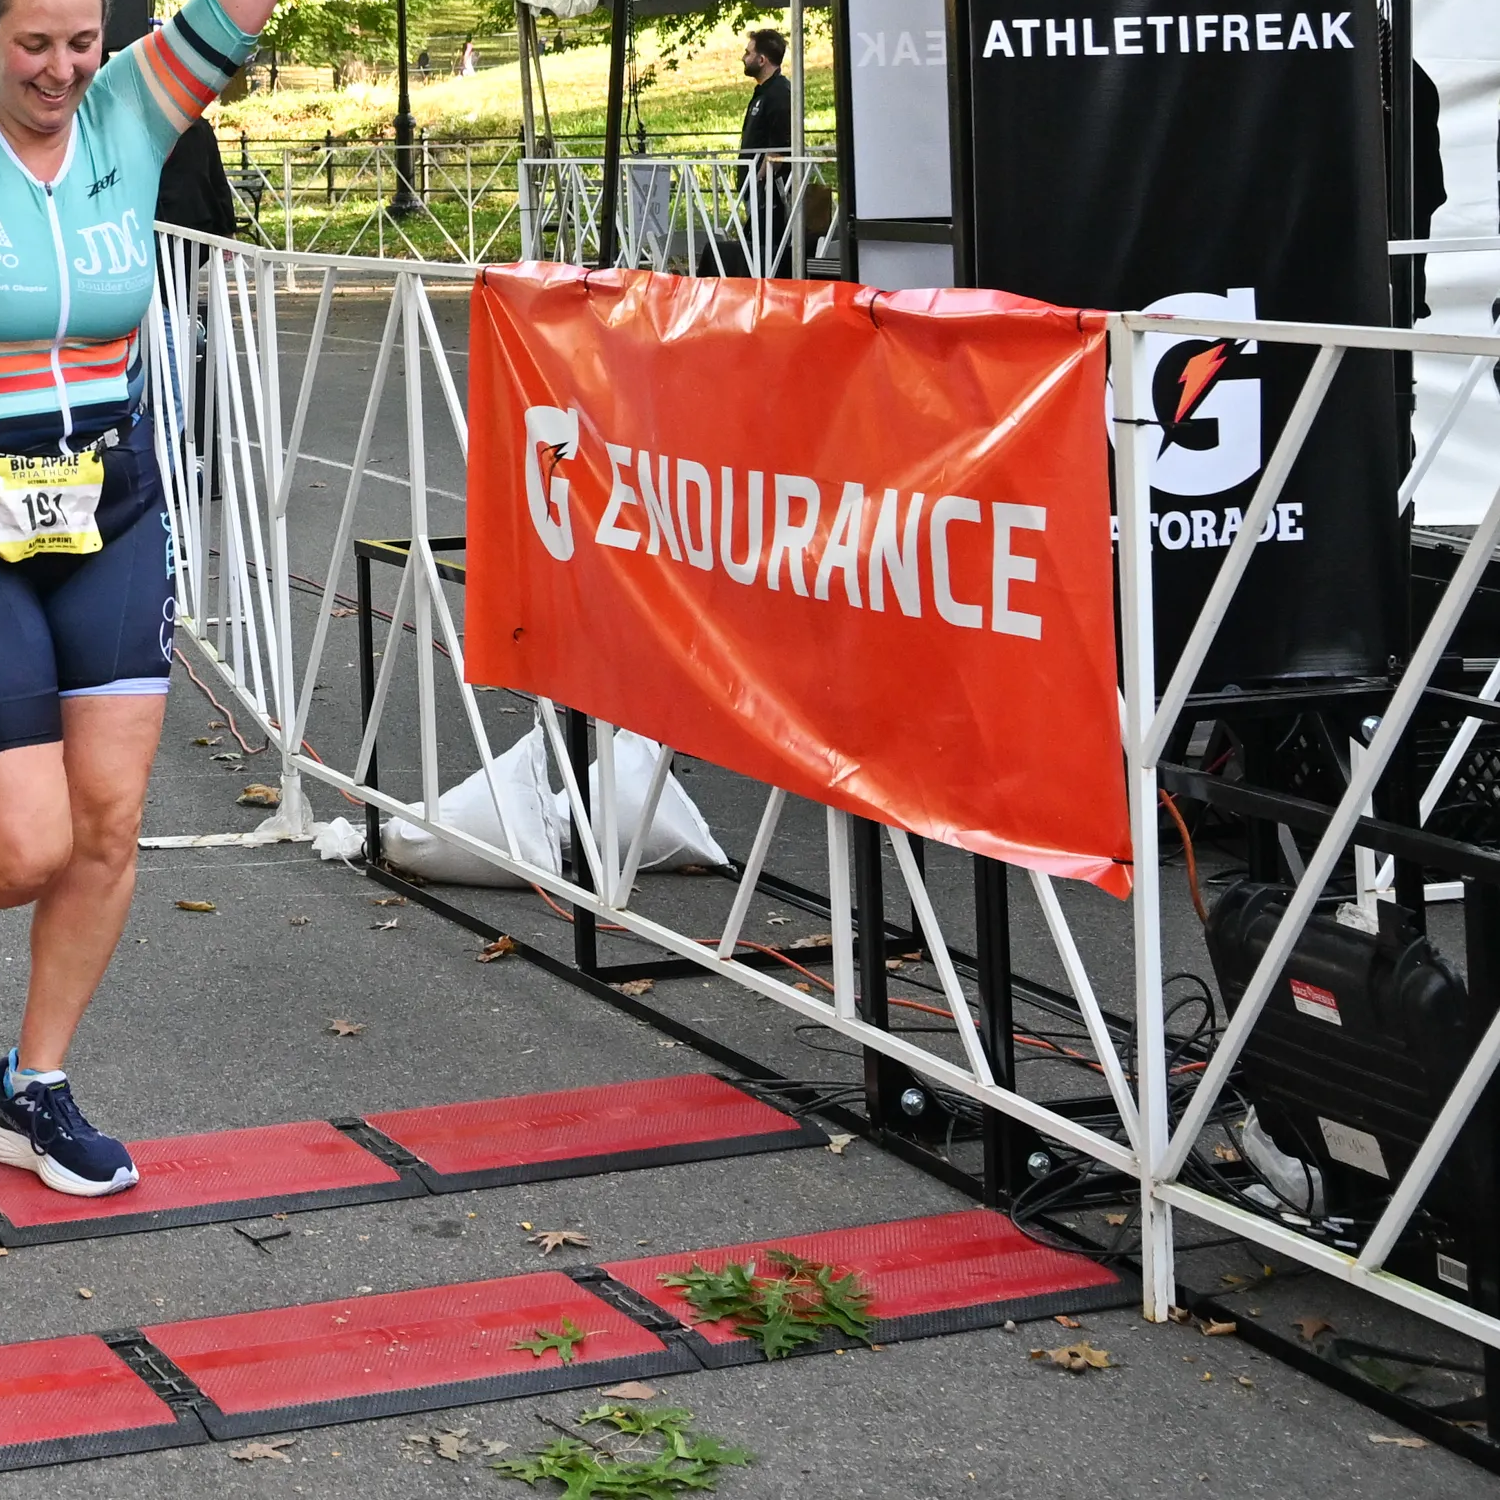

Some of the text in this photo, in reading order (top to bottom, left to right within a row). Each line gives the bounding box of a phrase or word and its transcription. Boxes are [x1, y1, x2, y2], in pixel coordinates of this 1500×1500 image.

[982, 11, 1355, 59] ATHLETIFREAK
[73, 207, 148, 276] JDC
[12, 284, 48, 293] Chapter
[77, 279, 123, 291] Boulder
[10, 453, 79, 471] BIG APPLE
[12, 468, 78, 479] TRIATHLON
[596, 442, 1047, 641] ENDURANCE
